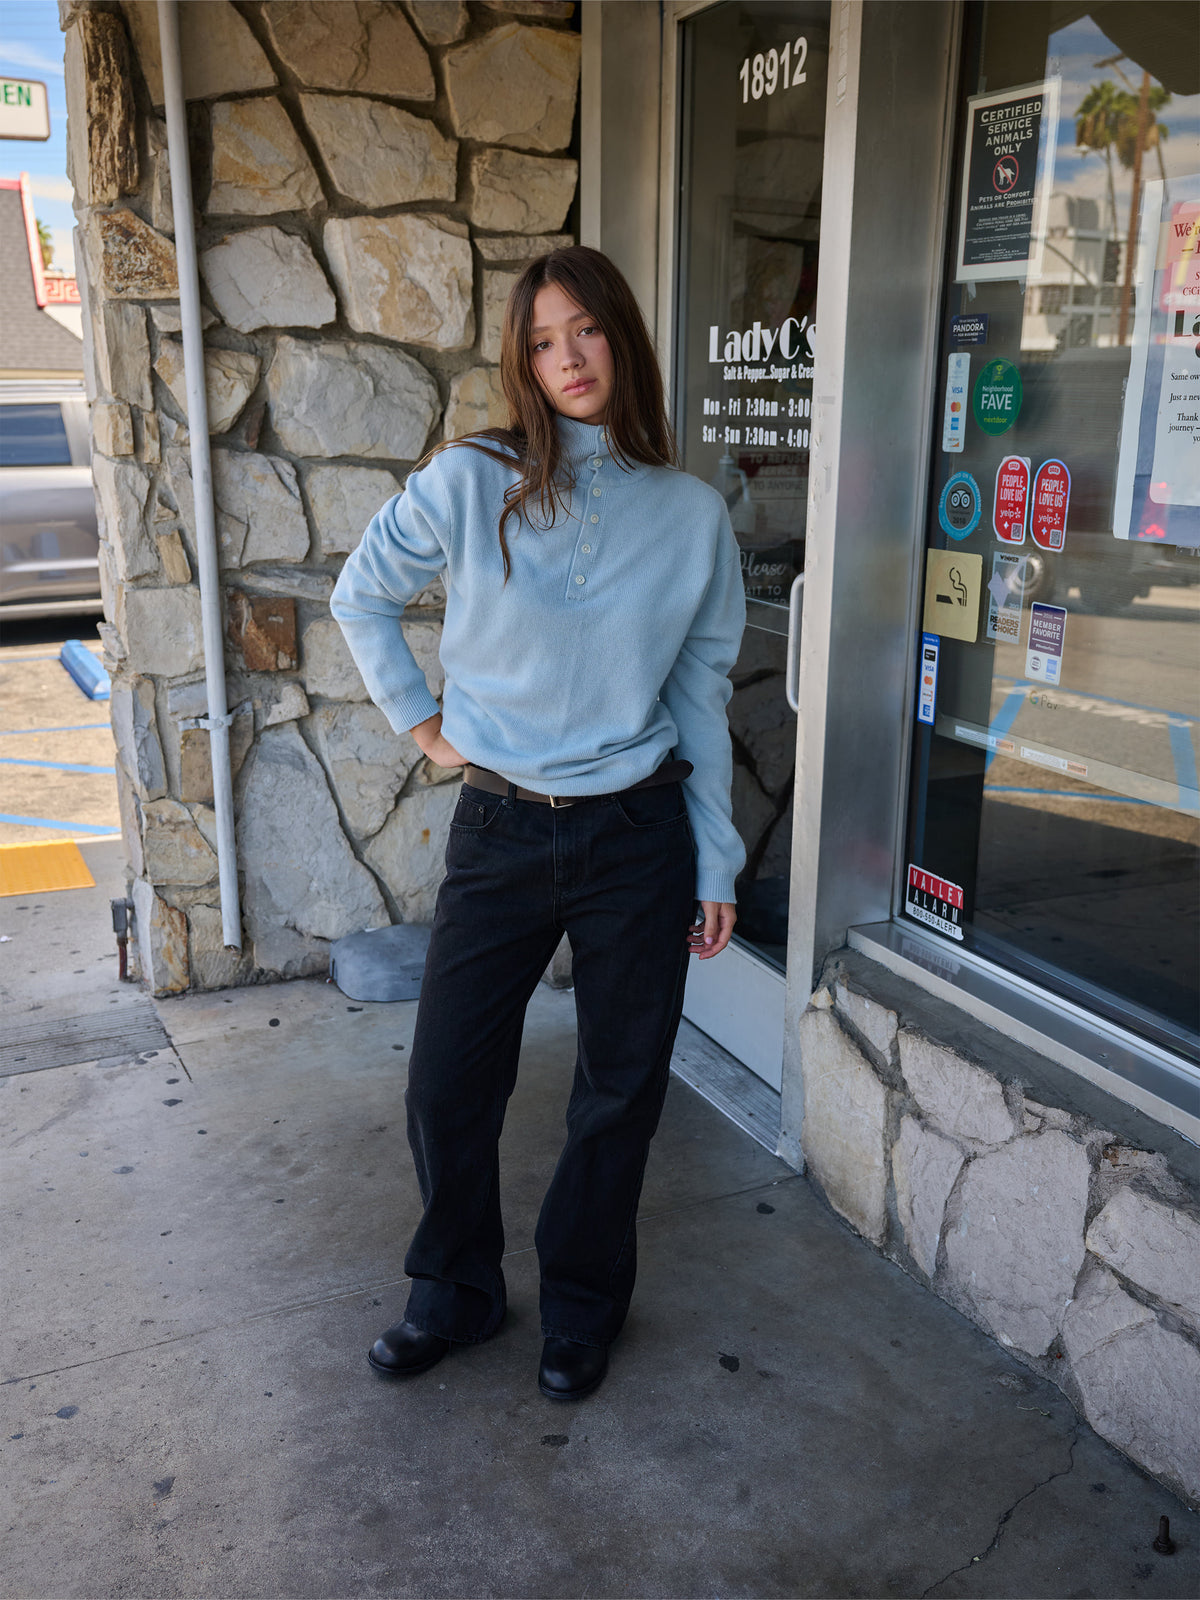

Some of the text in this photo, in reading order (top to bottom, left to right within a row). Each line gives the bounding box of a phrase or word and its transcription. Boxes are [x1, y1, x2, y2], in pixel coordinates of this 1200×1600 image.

[740, 37, 808, 104] 18912
[0, 84, 32, 106] EN
[981, 101, 1042, 123] CERTIFIED
[988, 117, 1032, 135] SERVICE
[985, 129, 1033, 147] ANIMALS
[994, 142, 1022, 156] ONLY
[953, 323, 984, 333] PANDORA
[723, 365, 736, 380] Salt
[737, 366, 743, 380] &
[791, 364, 797, 379] &
[1170, 373, 1189, 381] Same
[952, 386, 963, 394] VISA
[982, 385, 1013, 394] Neighborhood
[981, 394, 1013, 411] FAVE
[1168, 393, 1182, 404] Just
[703, 398, 720, 416] Mon
[728, 398, 741, 416] Fri
[745, 398, 778, 417] 7:30am
[788, 398, 812, 418] 3:00
[983, 416, 1008, 424] nextdoor
[1177, 412, 1199, 421] Thank
[1168, 423, 1195, 434] journey
[702, 425, 717, 443] Sat
[724, 426, 740, 444] Sun
[745, 426, 777, 446] 7:30am
[787, 428, 811, 448] 4:00
[1002, 474, 1024, 488] PEOPLE
[1041, 478, 1064, 493] PEOPLE
[1000, 488, 1024, 502] LOVE US
[1039, 492, 1064, 508] LOVE US
[1000, 508, 1015, 519] yelp
[1038, 514, 1053, 525] yelp
[745, 585, 782, 597] AIT TO
[990, 615, 1019, 629] READERS
[1032, 619, 1062, 632] MEMBER
[992, 624, 1018, 637] CHOICE
[1032, 627, 1060, 640] FAVORITE
[925, 664, 935, 672] VISA
[913, 870, 962, 907] VALLEY
[913, 889, 959, 924] ALARM
